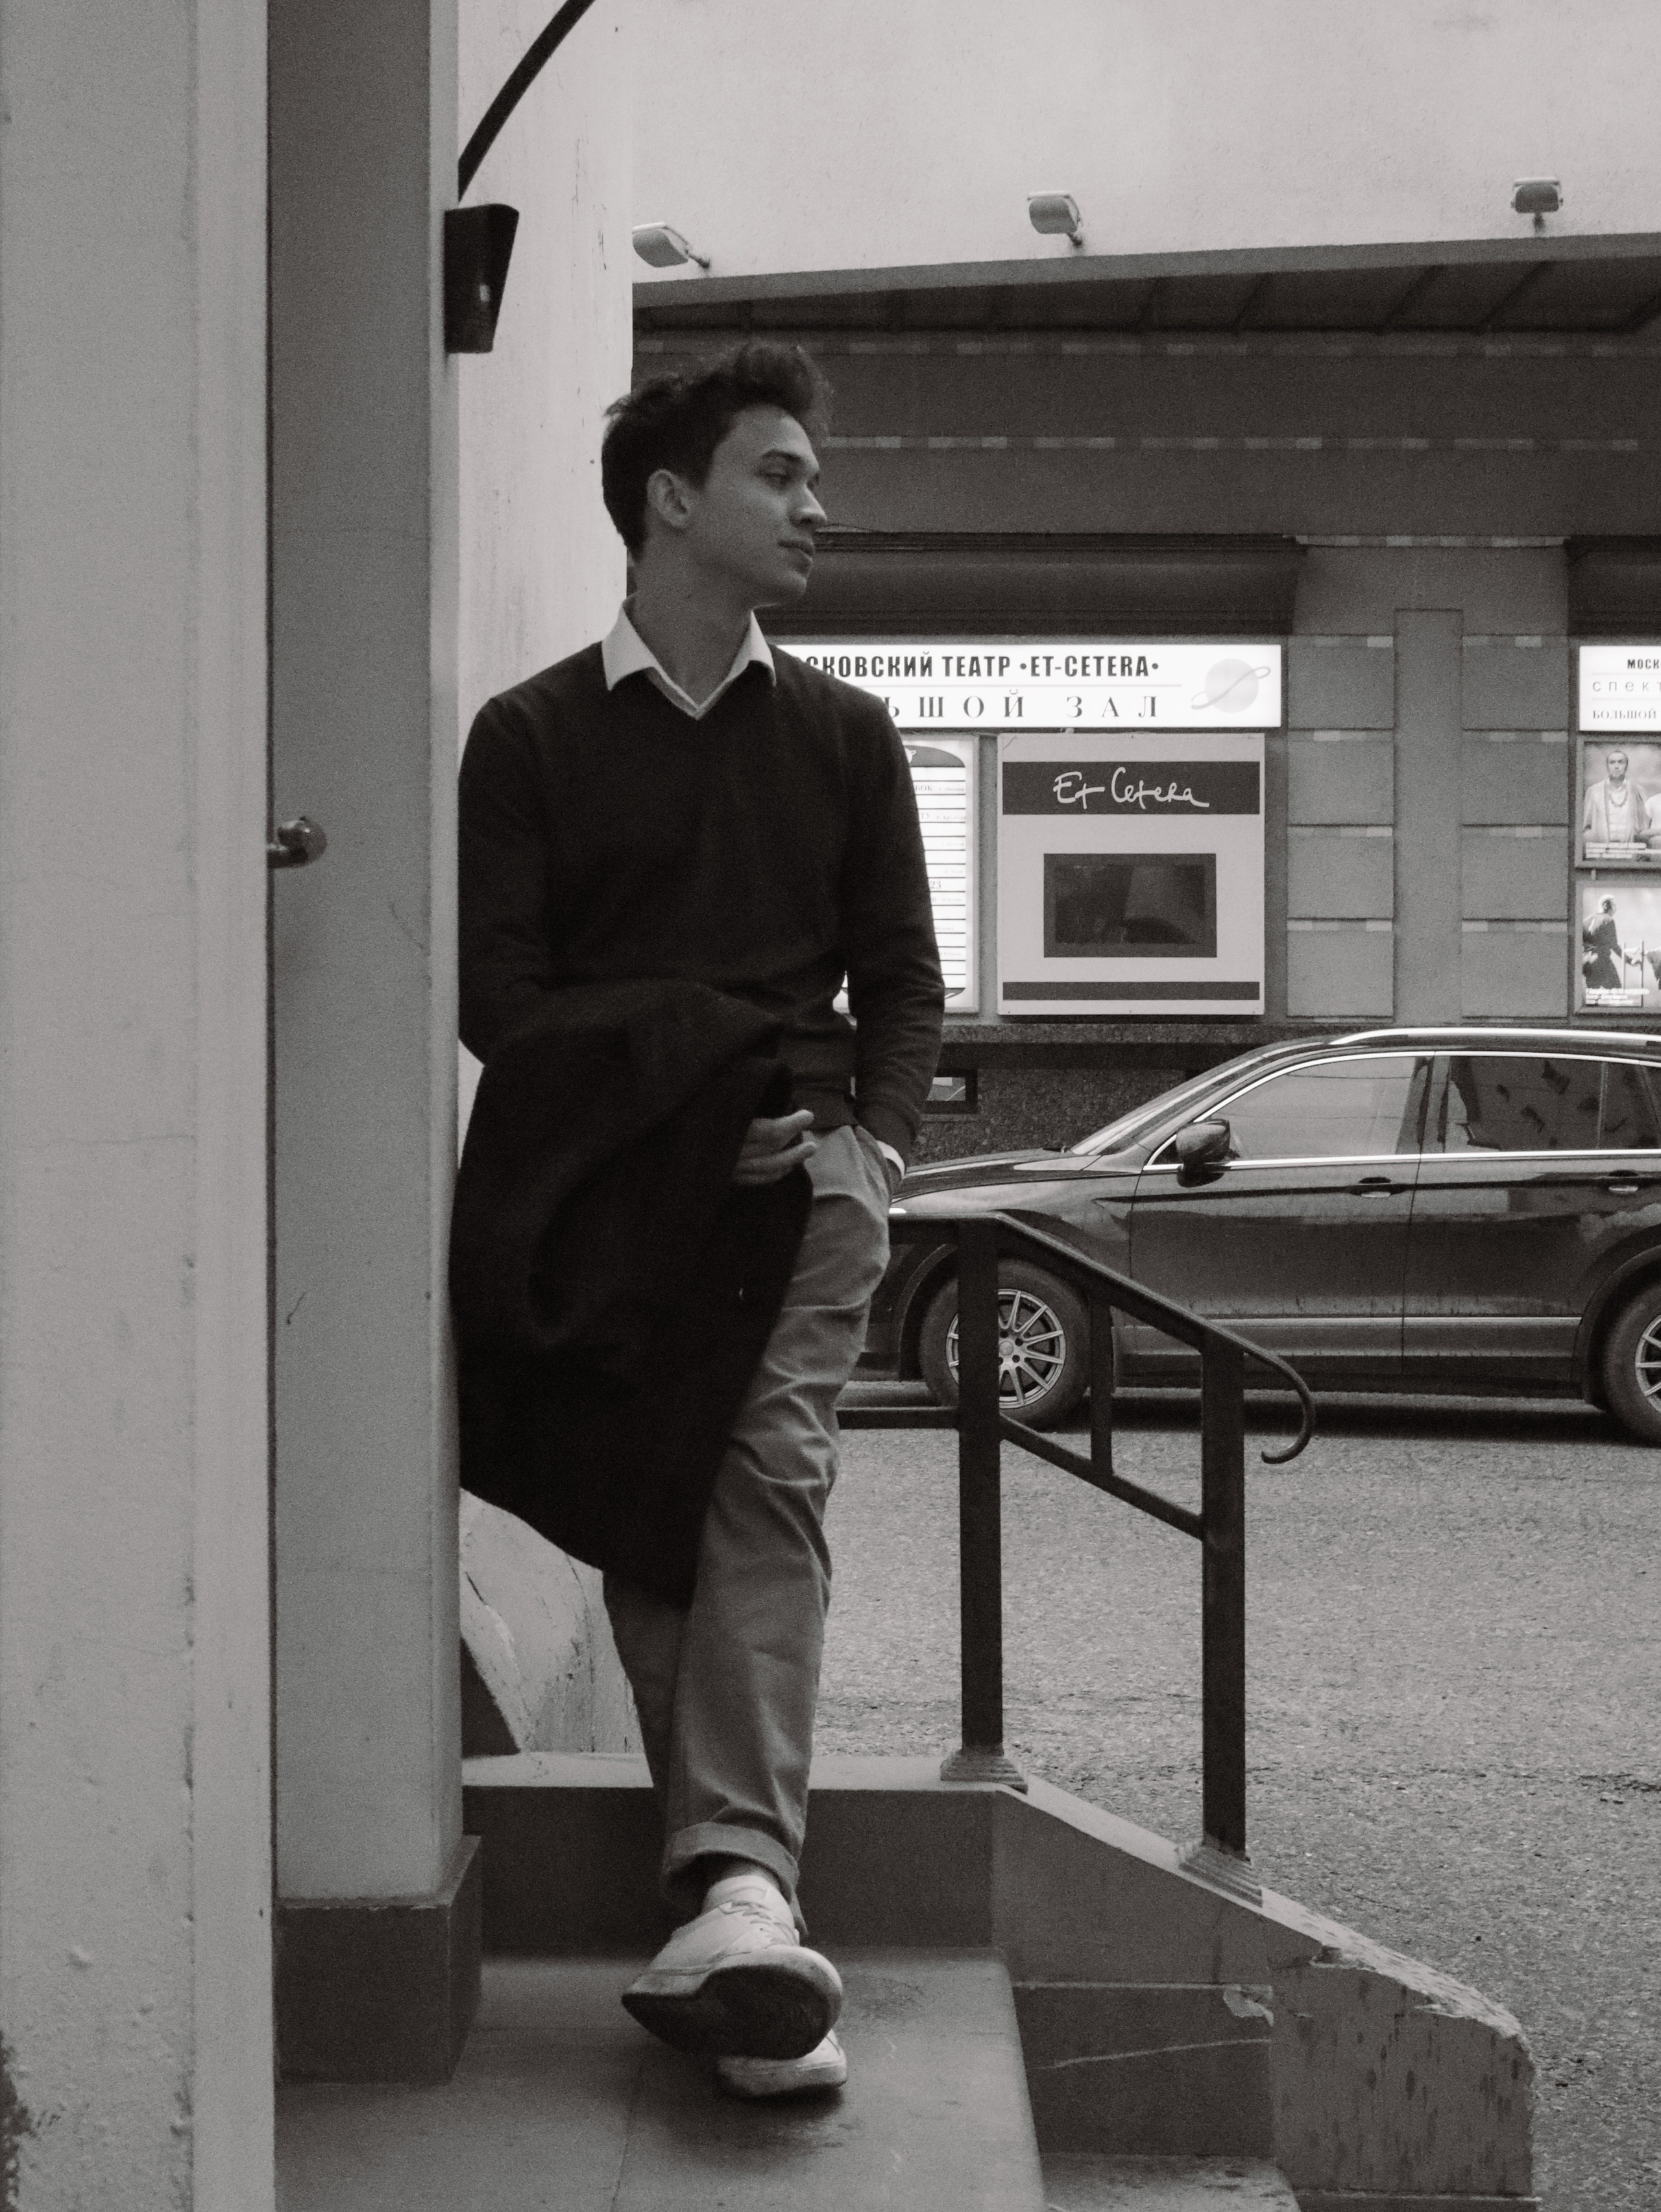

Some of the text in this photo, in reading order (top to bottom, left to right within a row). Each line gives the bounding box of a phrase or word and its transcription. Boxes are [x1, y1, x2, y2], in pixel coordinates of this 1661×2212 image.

[942, 656, 1011, 677] ТЕАТР
[1066, 696, 1158, 718] ЗАЛ
[1592, 707, 1656, 719] БОЛЬШОЙ
